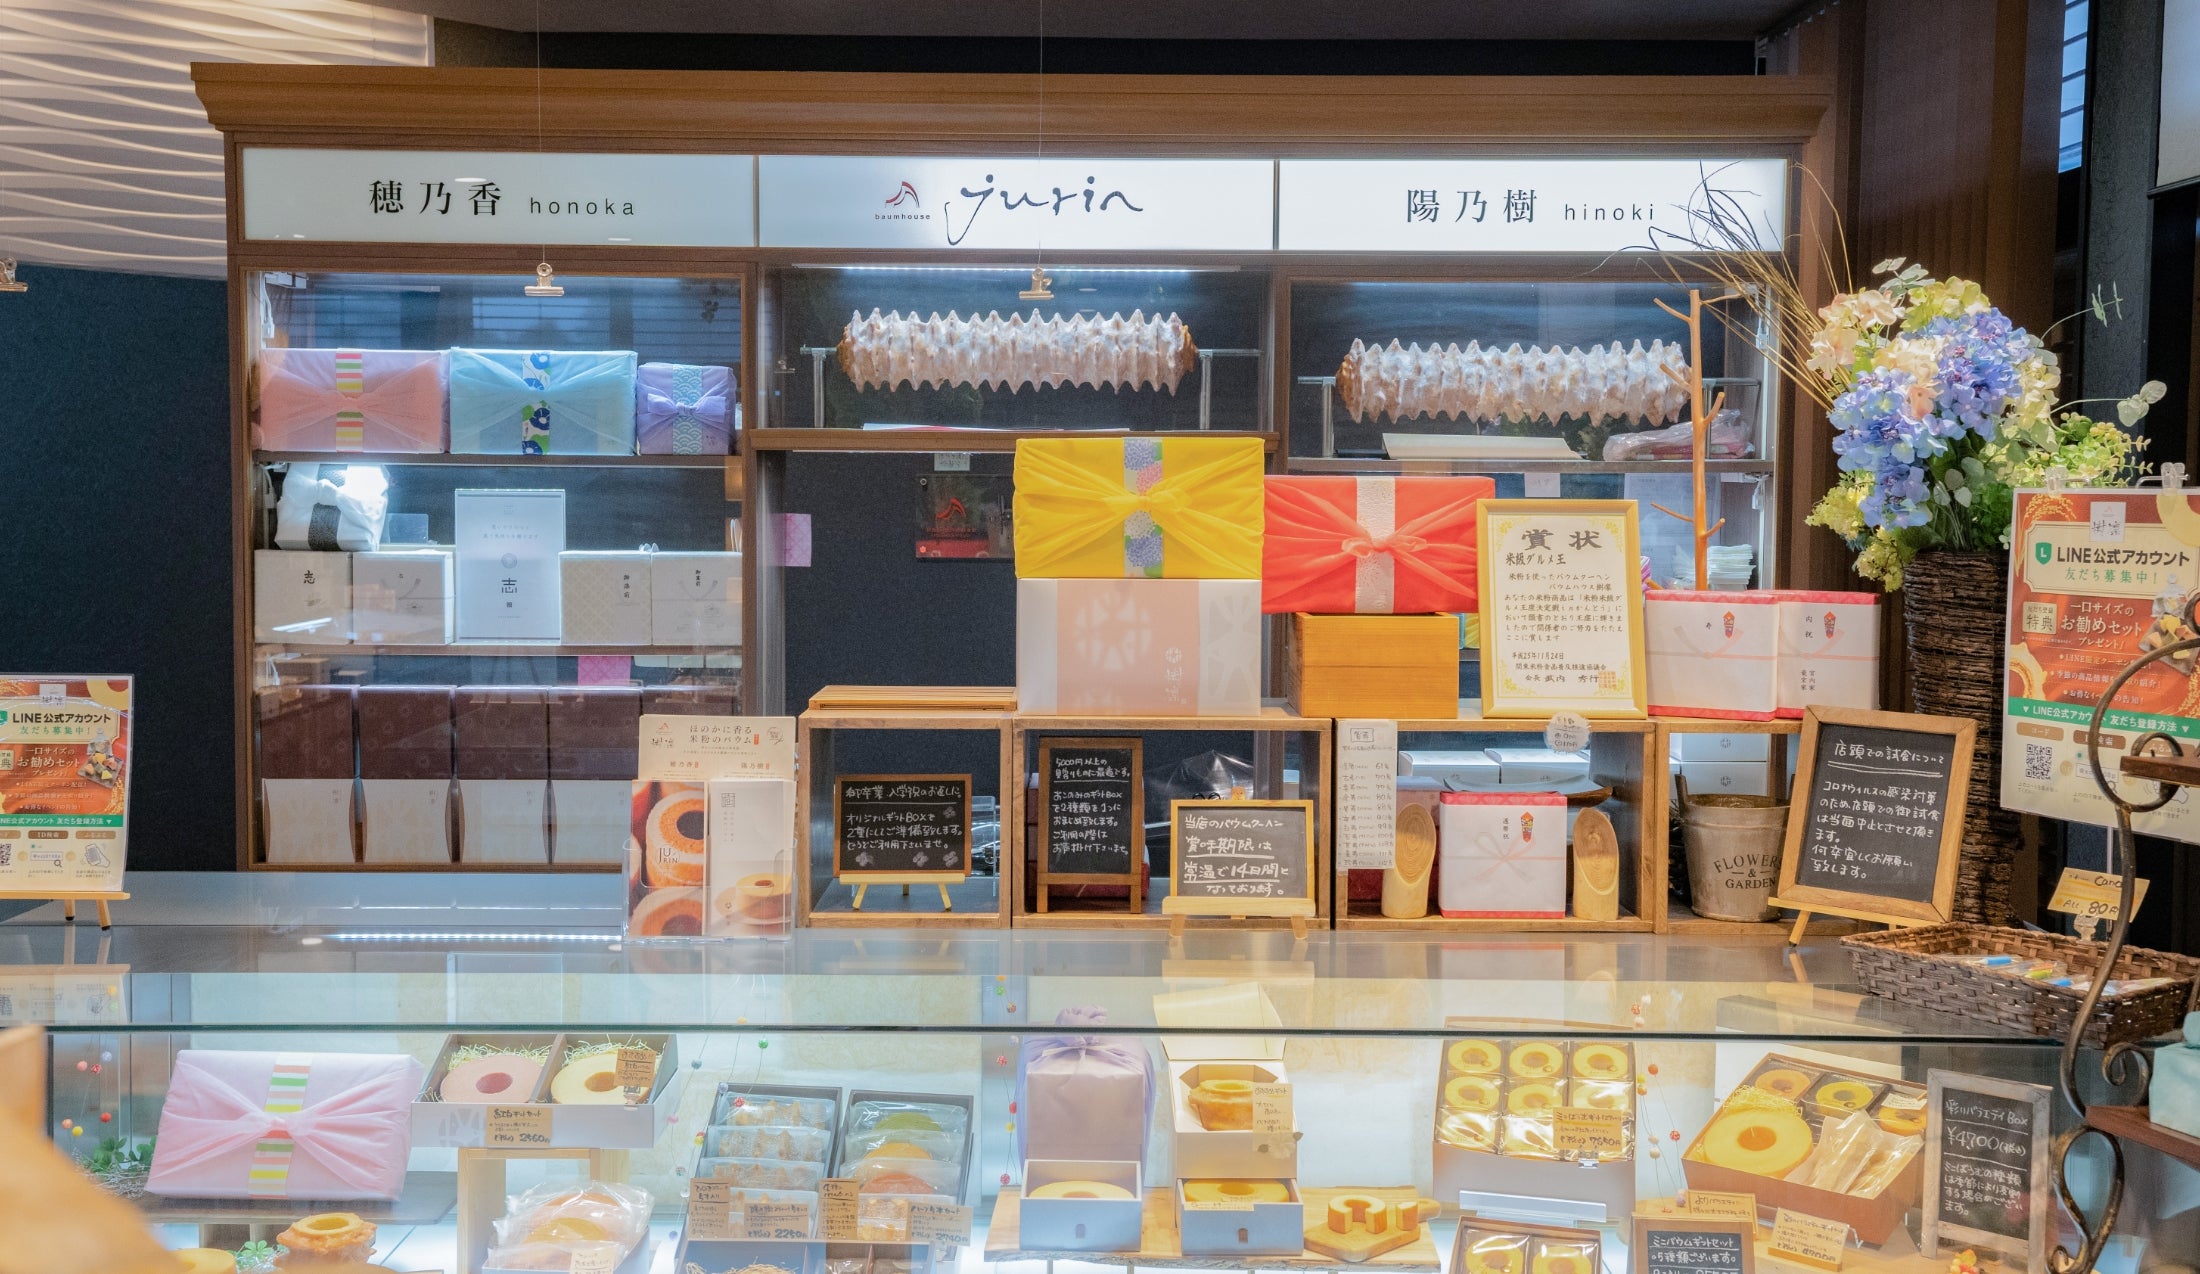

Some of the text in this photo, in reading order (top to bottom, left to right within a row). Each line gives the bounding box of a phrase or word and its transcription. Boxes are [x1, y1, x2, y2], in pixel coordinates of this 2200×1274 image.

[369, 180, 634, 216] 穂乃香 honoka
[1406, 189, 1654, 223] 陽乃樹 hinoki
[944, 174, 1143, 246] jurin
[1521, 528, 1602, 550] 賞状
[501, 577, 518, 594] 志
[690, 725, 752, 734] ほのかに香る
[1834, 739, 1945, 764] 店頭での試食について
[1725, 877, 1776, 889] GARDEN
[1748, 868, 1757, 878] &
